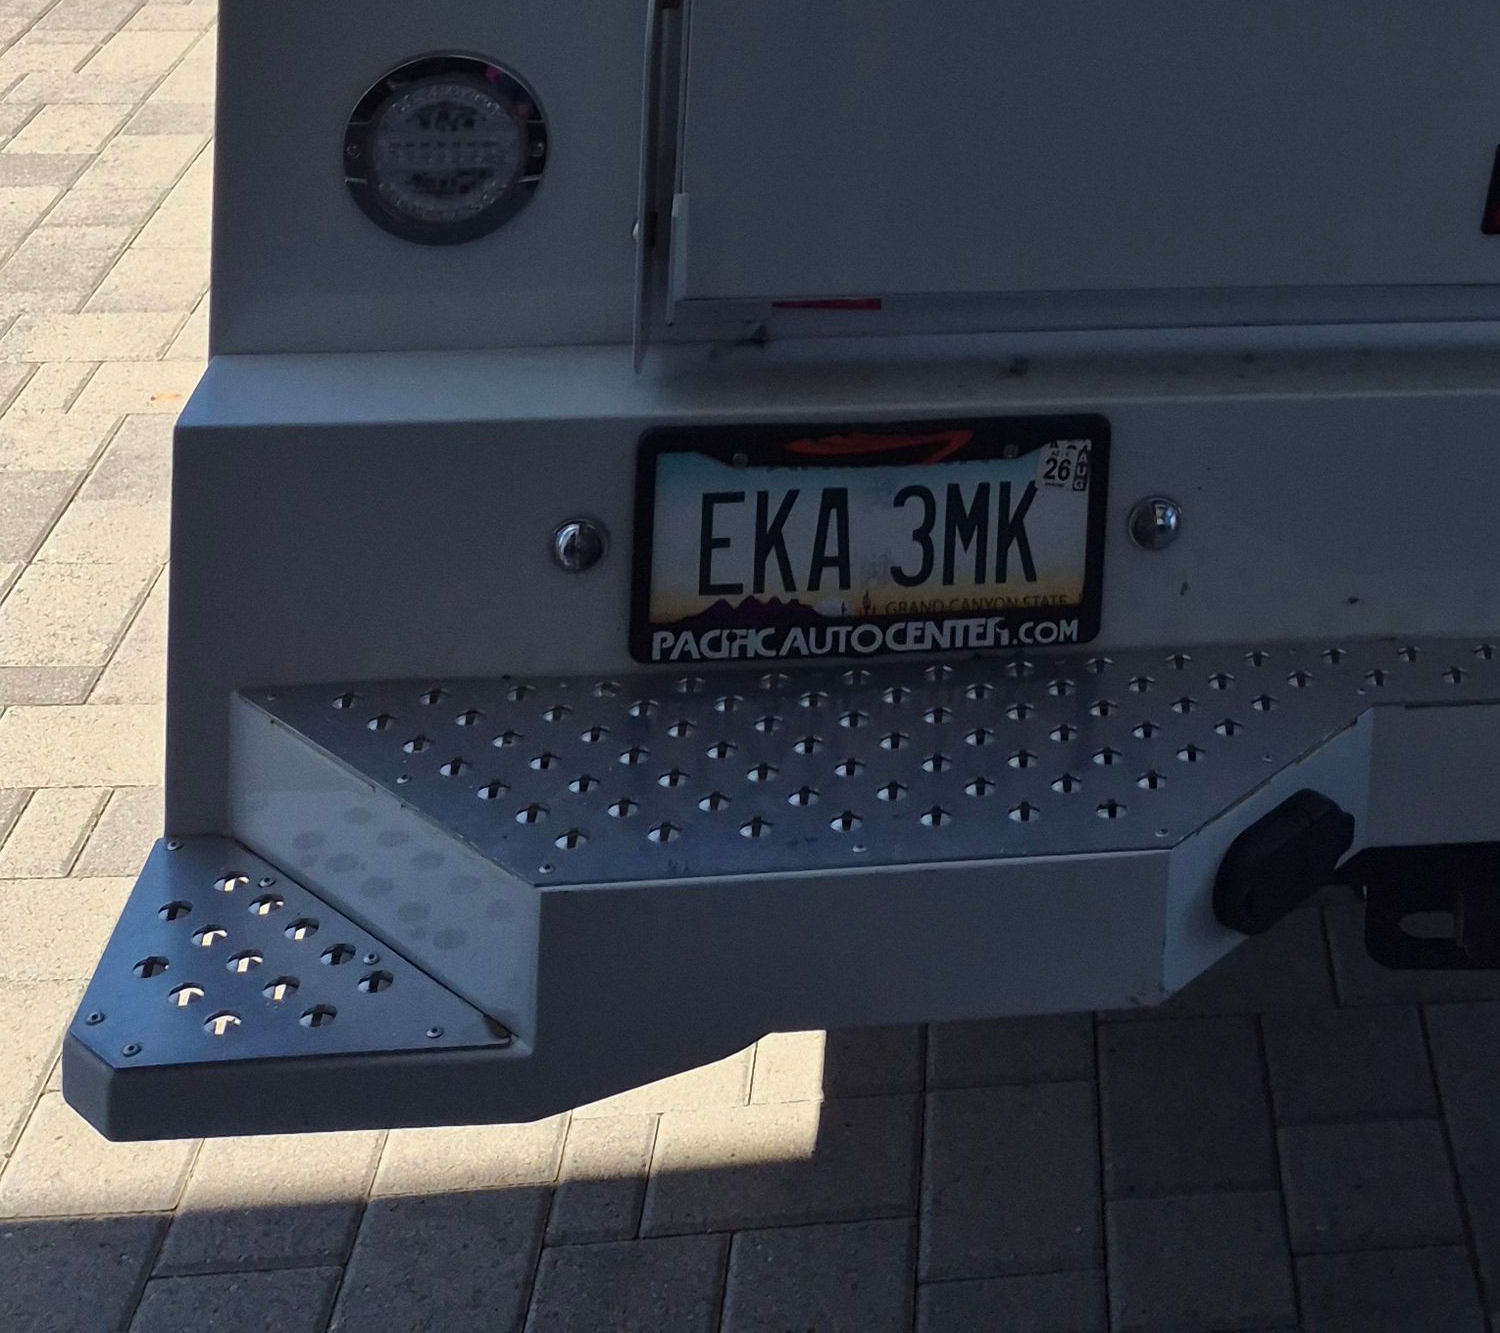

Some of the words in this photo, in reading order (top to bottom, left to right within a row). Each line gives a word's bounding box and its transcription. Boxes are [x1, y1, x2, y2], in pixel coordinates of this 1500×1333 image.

[1043, 458, 1071, 481] 26
[1074, 452, 1088, 489] AUG
[698, 486, 852, 597] EKA
[890, 480, 1039, 588] 3MK
[885, 599, 946, 615] GRAND
[949, 596, 1019, 612] CANYON
[1023, 594, 1068, 608] STATE
